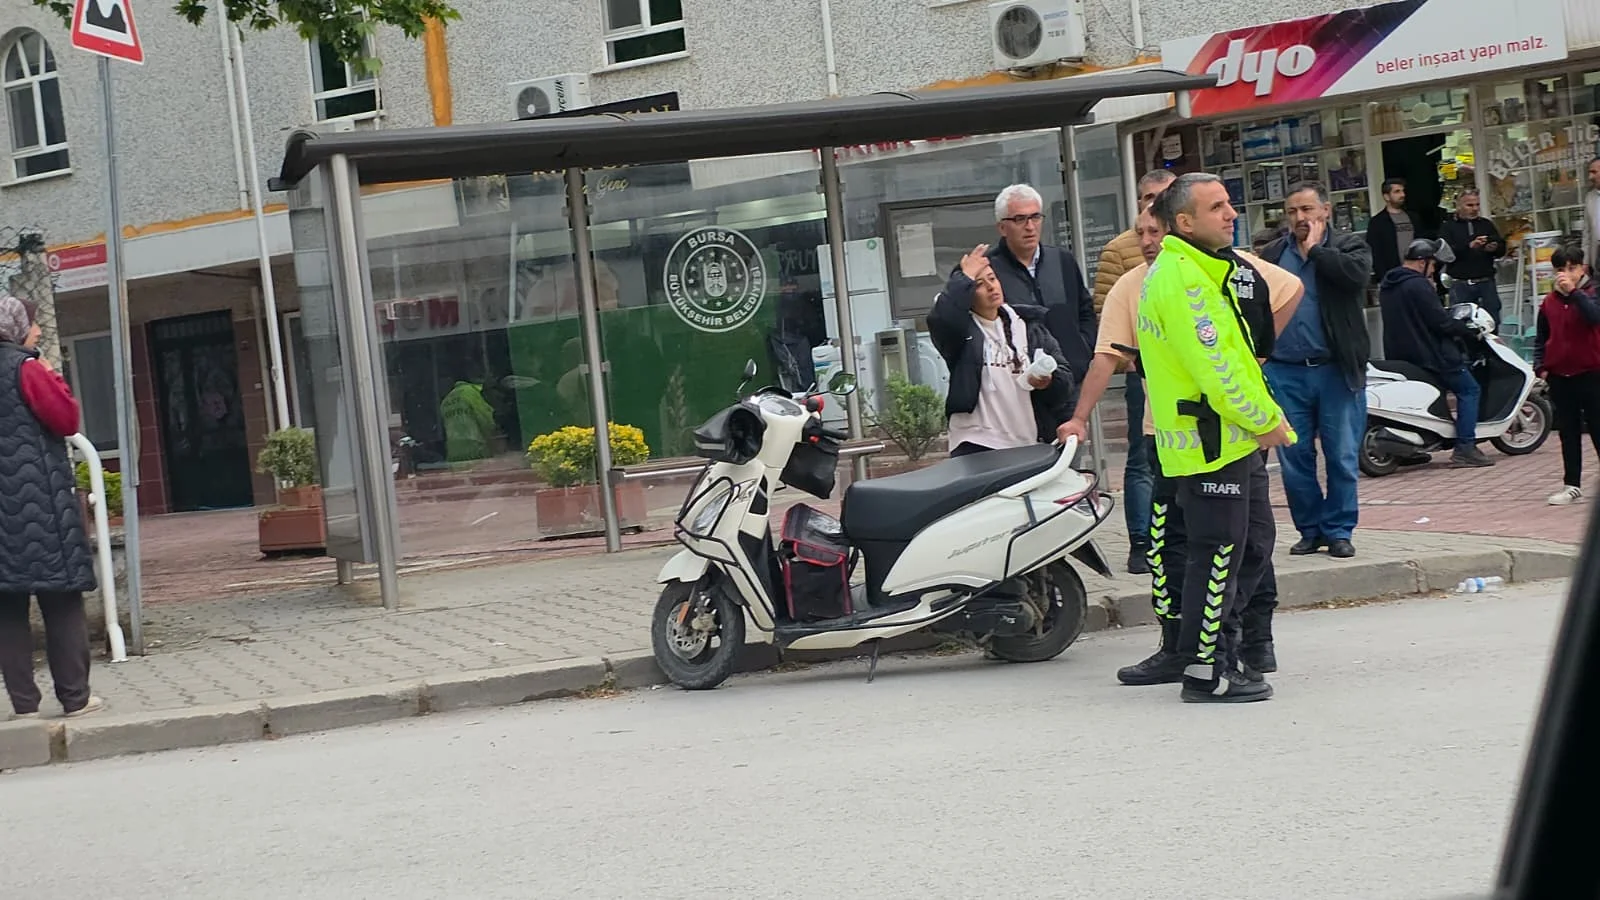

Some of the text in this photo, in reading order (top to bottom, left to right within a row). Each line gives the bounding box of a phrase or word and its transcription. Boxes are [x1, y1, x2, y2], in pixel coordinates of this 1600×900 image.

[1205, 39, 1317, 97] dyo
[1376, 36, 1548, 74] beler inşaat yapı malz.
[687, 231, 735, 249] BURSA
